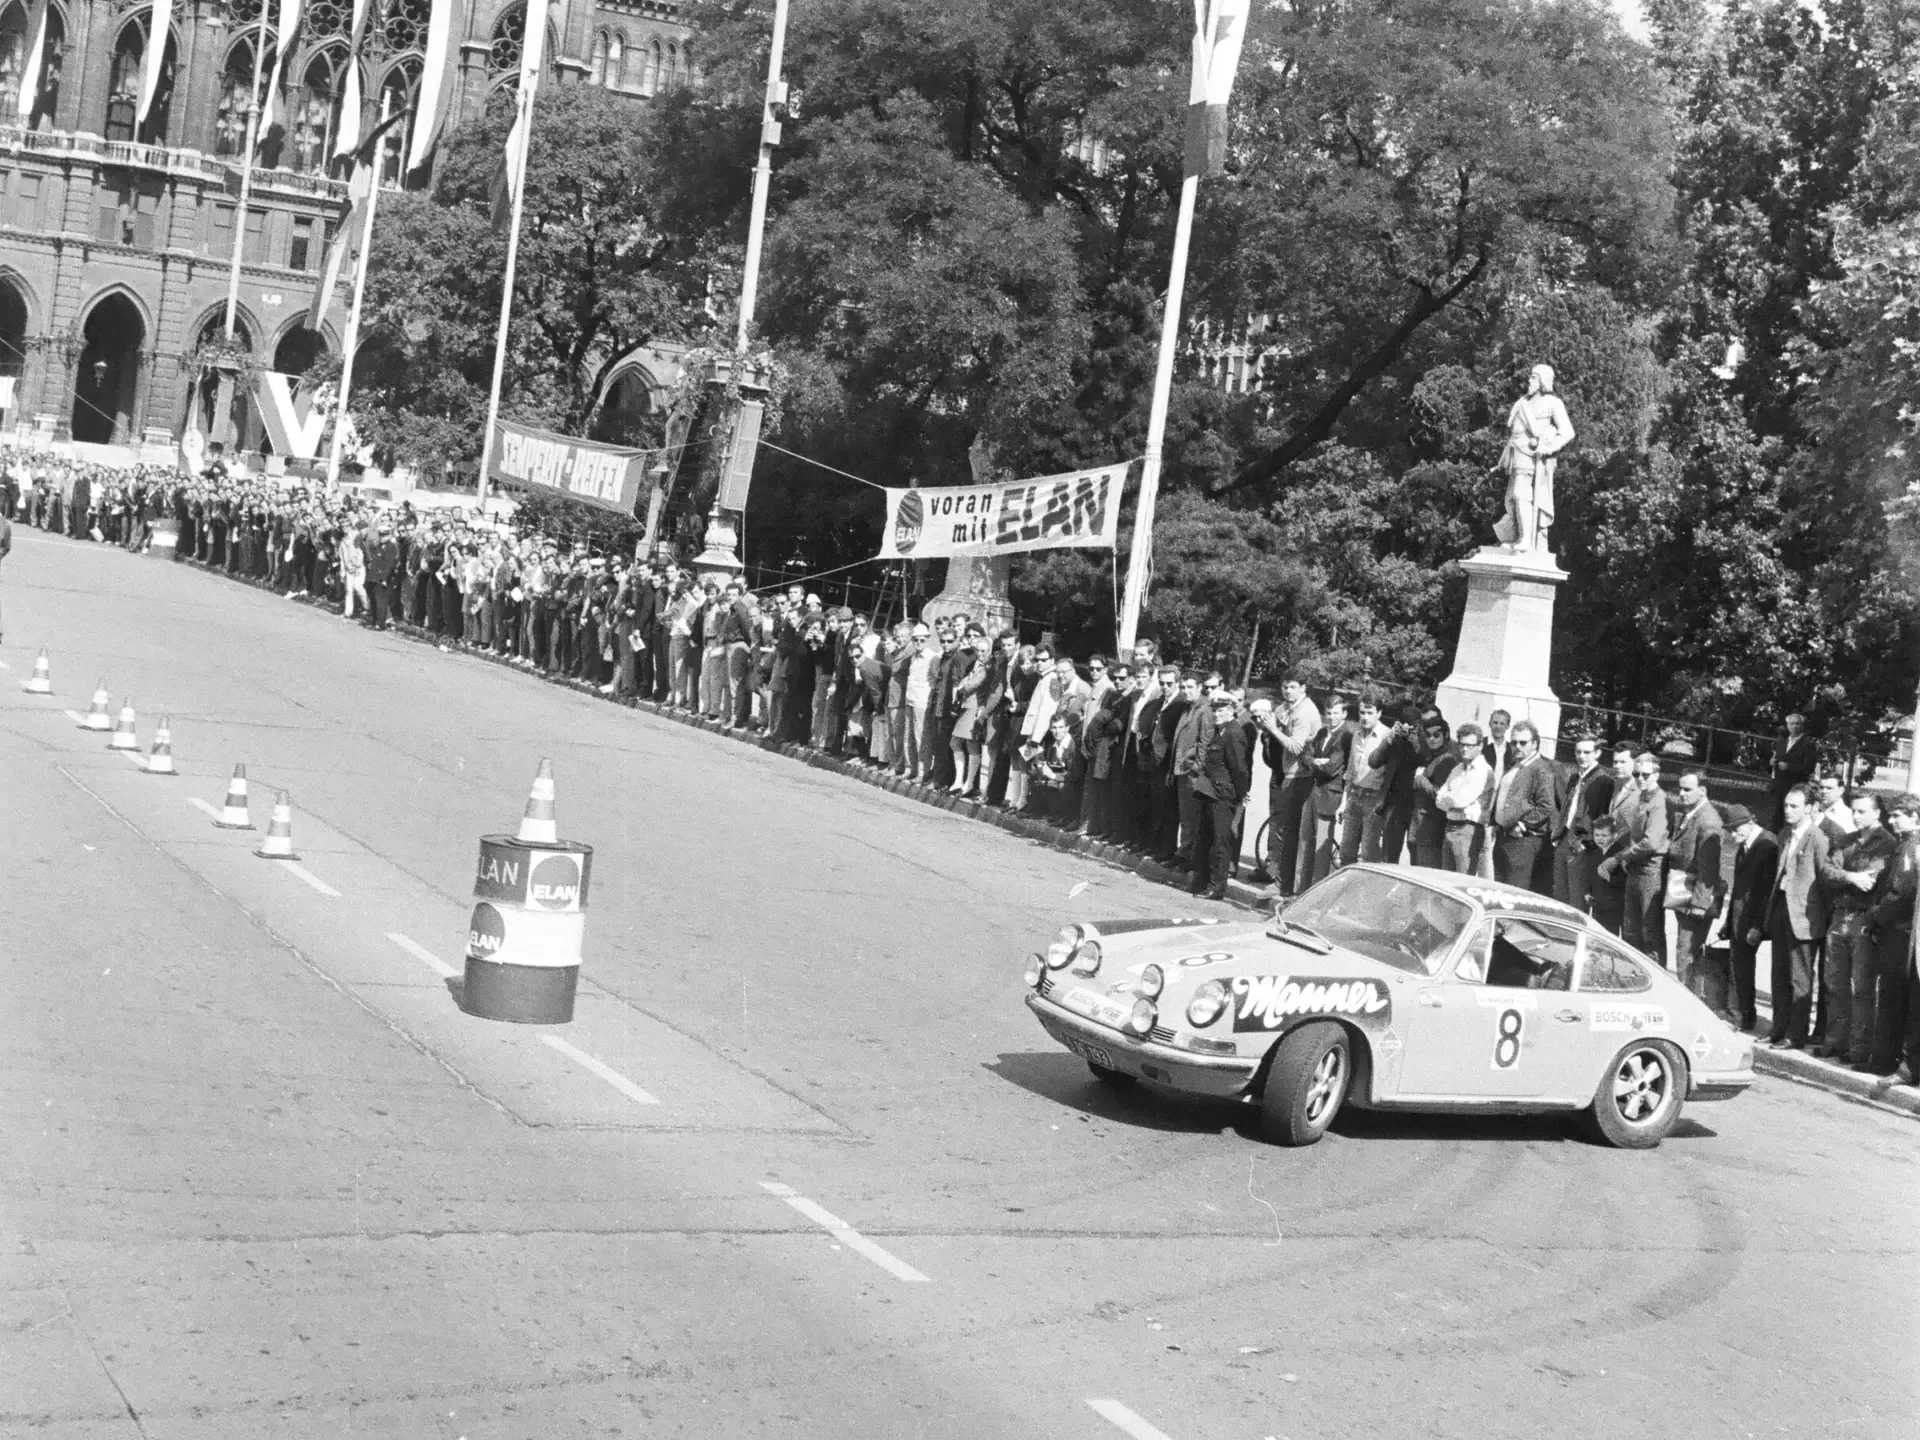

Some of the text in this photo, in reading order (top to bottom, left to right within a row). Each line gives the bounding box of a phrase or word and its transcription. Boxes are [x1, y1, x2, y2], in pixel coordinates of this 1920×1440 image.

[930, 474, 1111, 545] voran ELAN
[952, 515, 988, 543] mit
[533, 884, 578, 901] ELAN
[469, 930, 501, 950] ELAN
[1232, 975, 1389, 1028] Manner
[1595, 1011, 1630, 1023] BOSCH
[1494, 1008, 1522, 1068] 8
